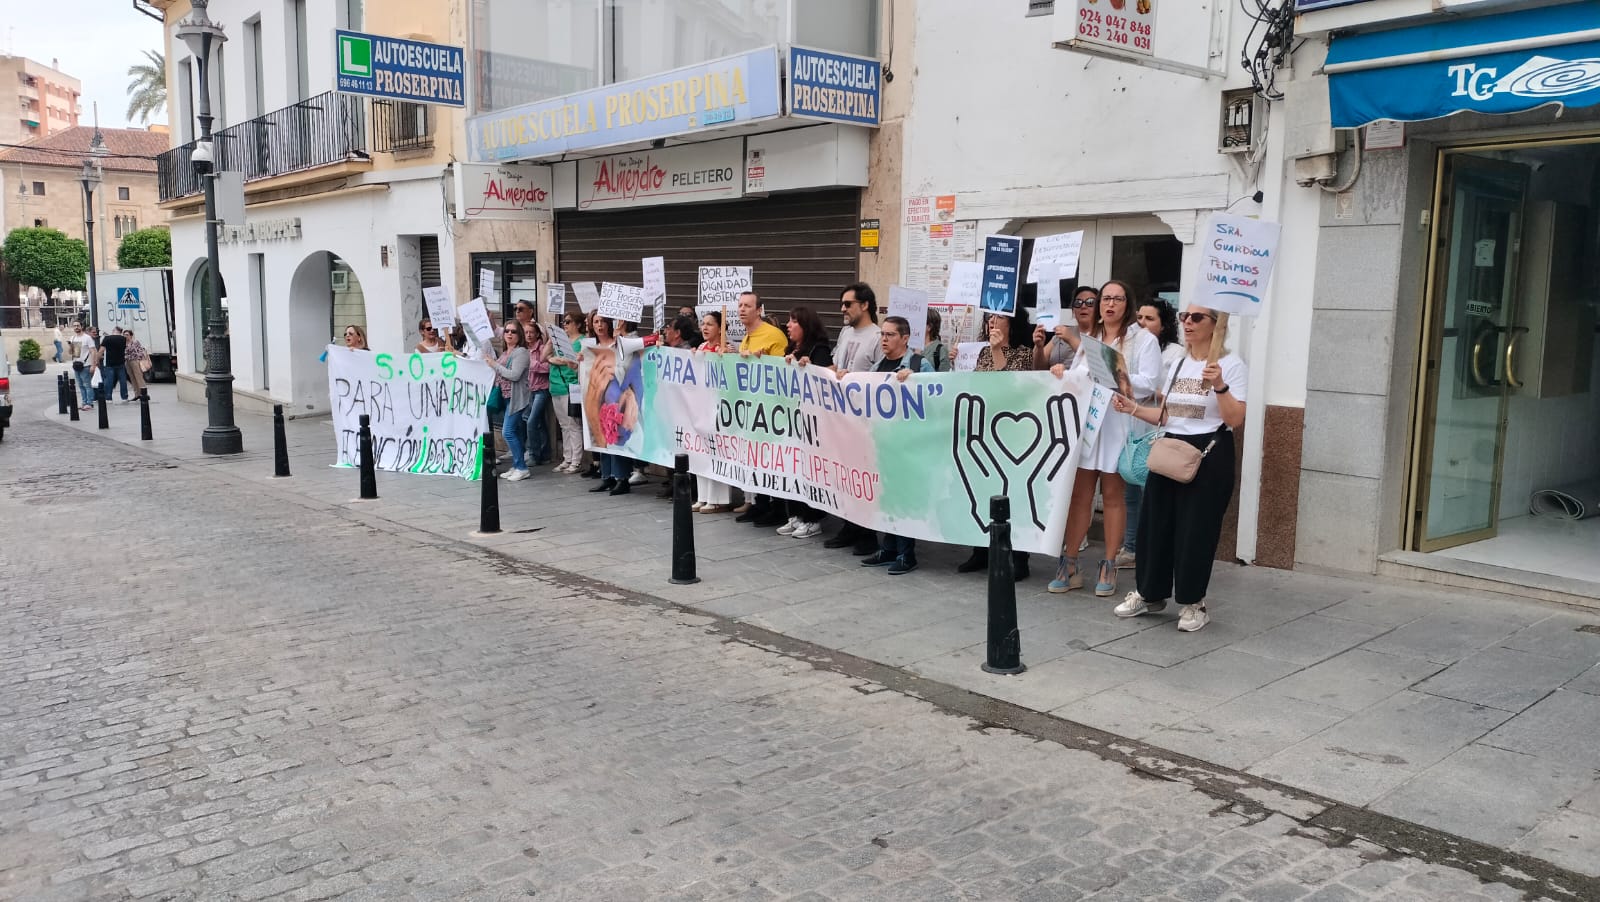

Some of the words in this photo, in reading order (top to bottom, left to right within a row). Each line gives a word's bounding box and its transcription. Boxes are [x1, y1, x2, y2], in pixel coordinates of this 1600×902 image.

[1079, 23, 1100, 38] 623
[1106, 29, 1128, 44] 240
[1134, 36, 1151, 50] 031
[1080, 8, 1101, 24] 924
[1105, 15, 1127, 30] 047
[1129, 21, 1151, 36] 848
[343, 40, 368, 73] L
[374, 41, 462, 74] AUTOESCUELA
[795, 54, 876, 91] AUTOESCUELA
[375, 69, 462, 101] PROSERPINA
[1448, 63, 1497, 101] TG
[482, 101, 597, 149] AUTOESCUELA
[606, 67, 747, 129] PROSERPINA
[794, 83, 876, 119] PROSERPINA
[483, 178, 549, 207] Almendro
[593, 155, 667, 200] Almendro
[672, 168, 733, 187] PELETERO
[701, 268, 722, 279] POR
[726, 266, 739, 277] LA
[1207, 273, 1228, 285] UNA
[1231, 277, 1258, 288] SOLA
[602, 284, 624, 293] ESTE
[629, 287, 641, 295] ES
[702, 291, 740, 303] ASISTENC
[1466, 303, 1492, 314] ABIERTO
[704, 360, 728, 390] UNA
[735, 362, 801, 399] BUENA
[335, 378, 394, 424] PARA
[408, 379, 449, 420] UNA
[715, 398, 820, 447] ¡DOTACIÓN!
[763, 472, 779, 491] DE
[782, 476, 801, 495] LA
